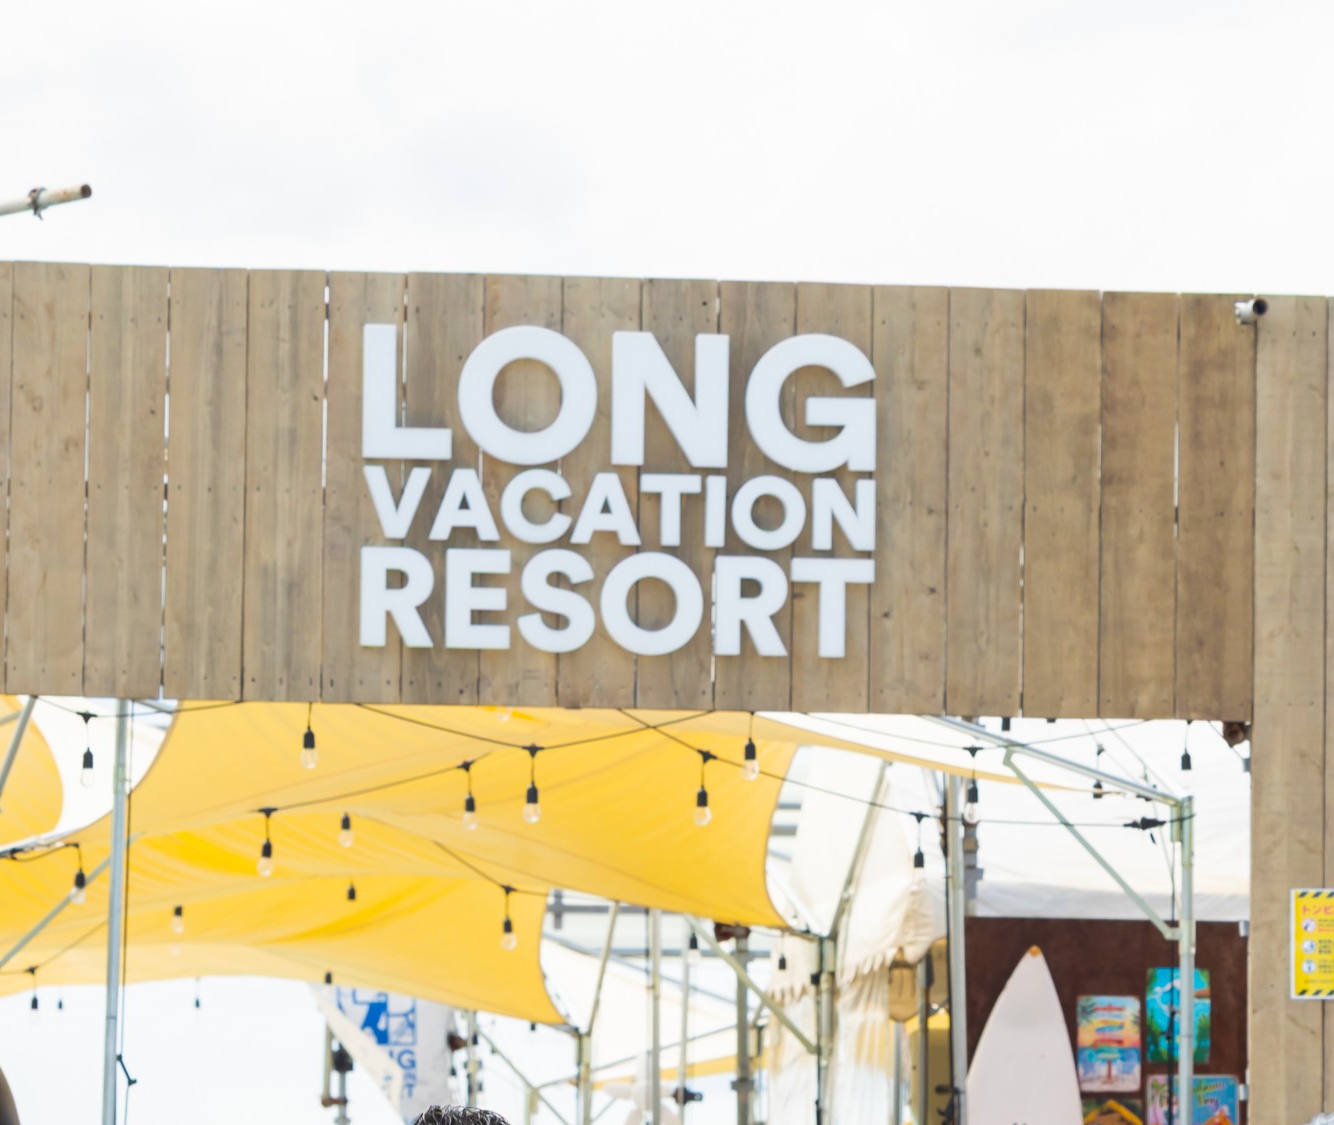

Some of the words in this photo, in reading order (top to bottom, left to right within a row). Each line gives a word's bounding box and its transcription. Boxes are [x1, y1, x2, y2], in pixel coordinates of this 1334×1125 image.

[361, 323, 877, 474] LONG
[363, 465, 877, 551] VACATION
[359, 546, 876, 658] RESORT
